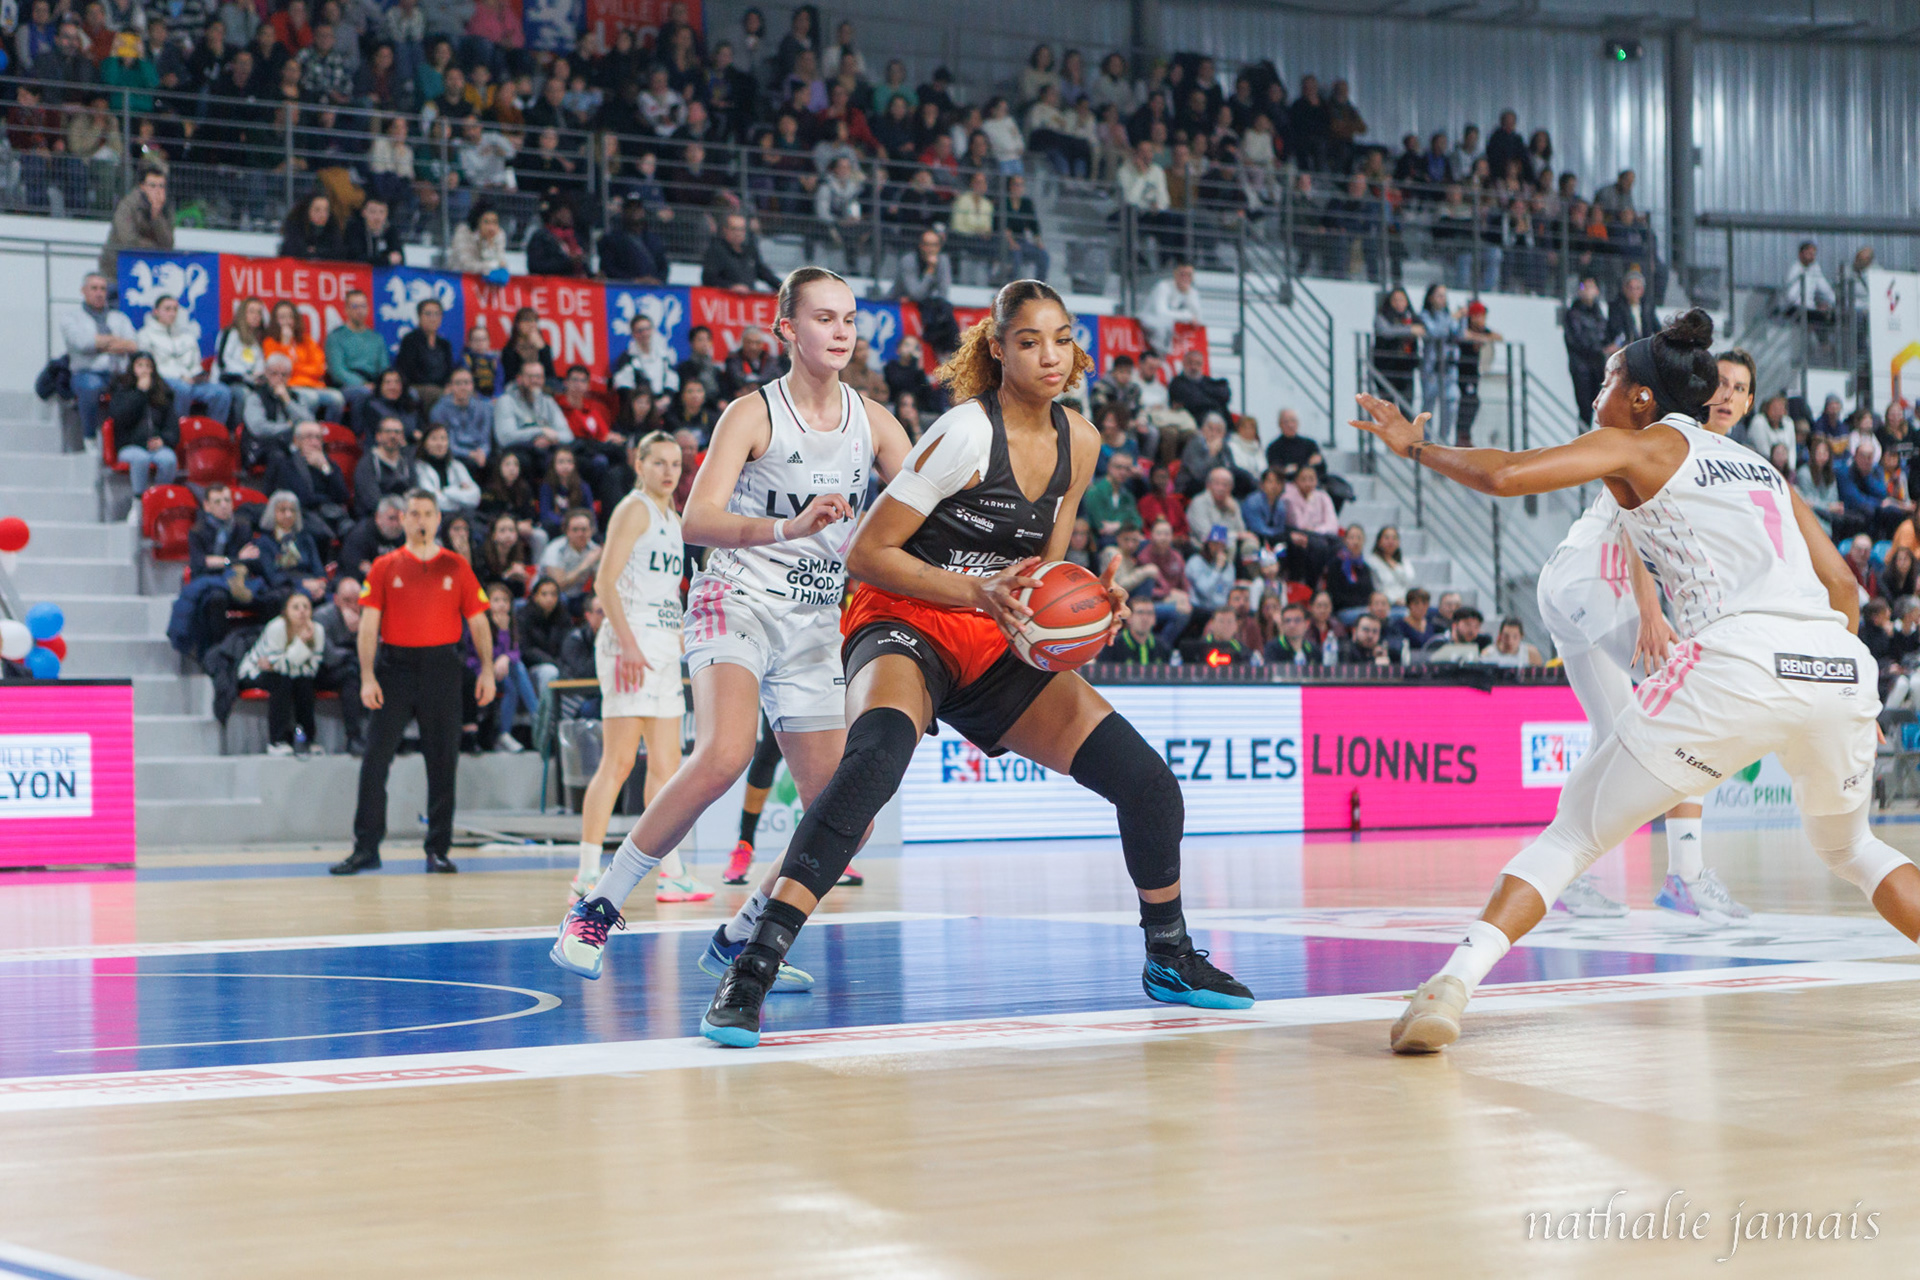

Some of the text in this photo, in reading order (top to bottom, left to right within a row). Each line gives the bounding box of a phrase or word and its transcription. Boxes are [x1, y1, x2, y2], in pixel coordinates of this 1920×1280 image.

[230, 264, 357, 301] VILLE DE
[557, 286, 592, 317] DE
[700, 297, 769, 328] VILLE
[1694, 458, 1784, 495] JANUARY
[766, 489, 867, 524] LYN
[979, 498, 1016, 510] TARMAK
[971, 514, 995, 530] dalkia
[649, 550, 683, 576] LYO
[797, 558, 845, 574] SMAR
[786, 569, 835, 591] GOOD
[789, 586, 840, 606] THINGS
[1780, 658, 1855, 676] RENT CAR
[1, 747, 76, 768] ILLE DE
[984, 757, 1047, 783] LYON
[1165, 733, 1478, 784] EZ LES LIONNES
[1674, 747, 1723, 779] In Extenso
[1754, 785, 1793, 805] PRIN
[752, 808, 787, 833] GG
[0, 1072, 251, 1092] ROPOLE
